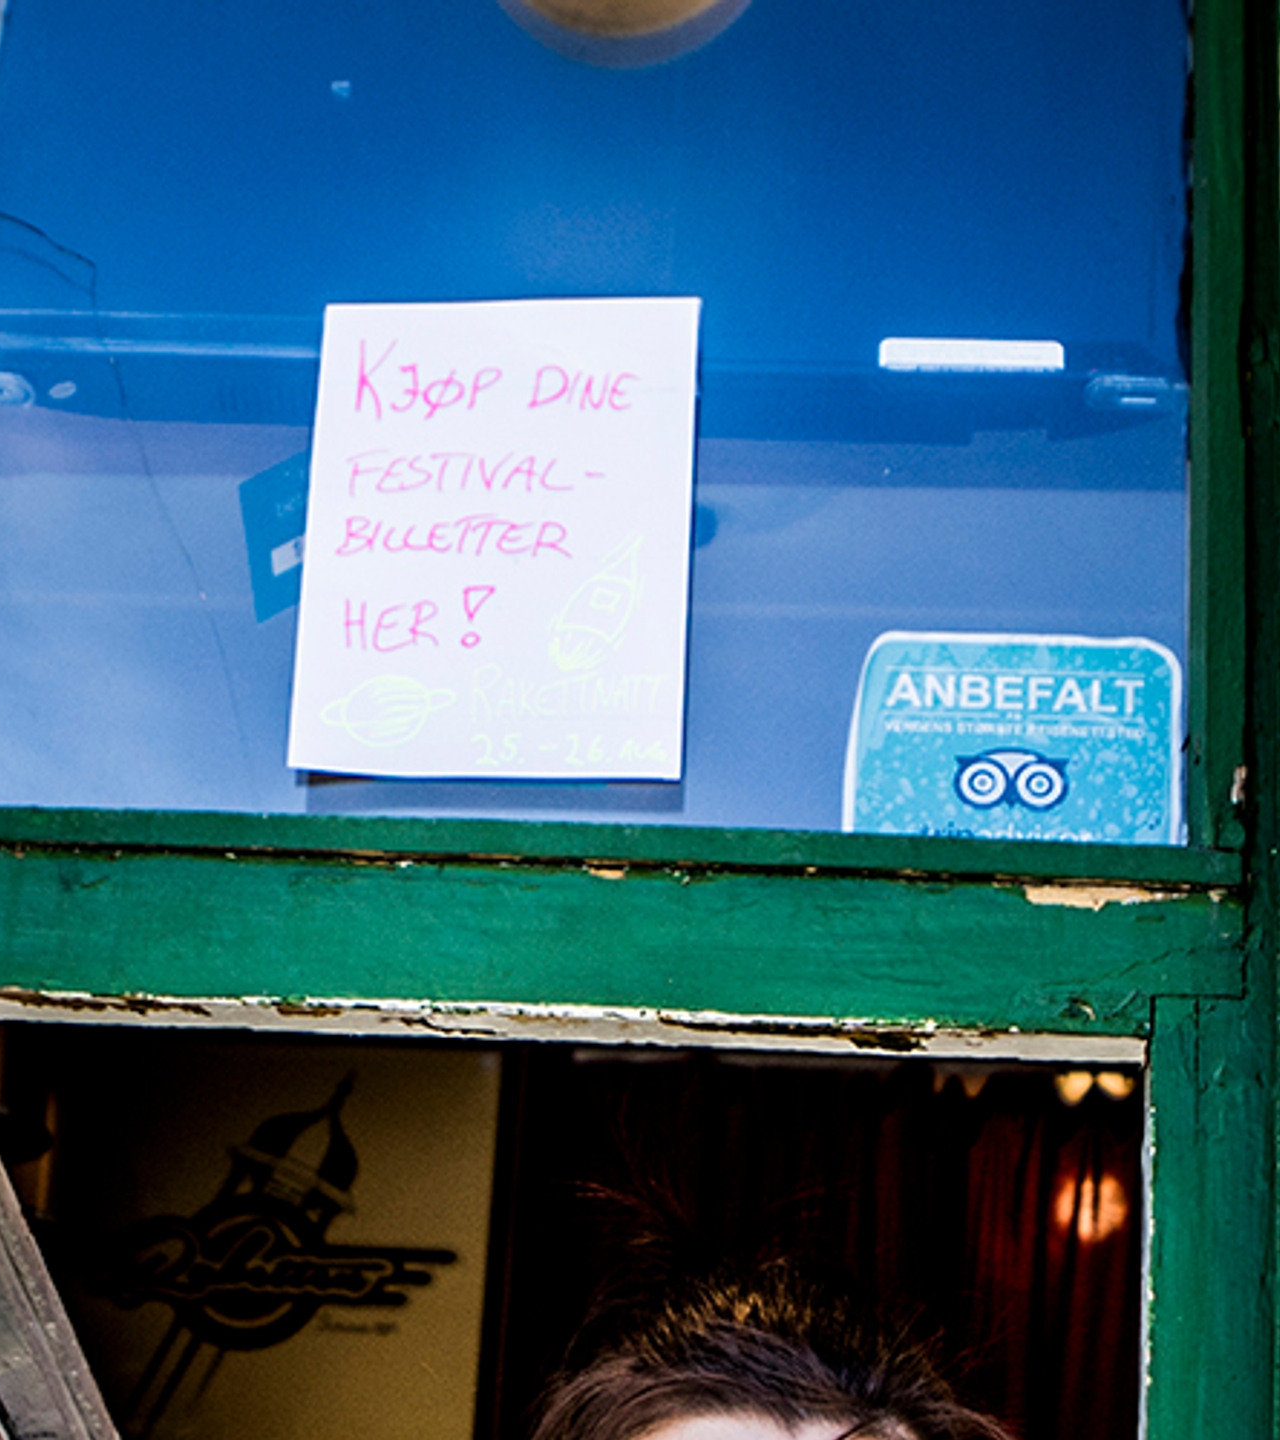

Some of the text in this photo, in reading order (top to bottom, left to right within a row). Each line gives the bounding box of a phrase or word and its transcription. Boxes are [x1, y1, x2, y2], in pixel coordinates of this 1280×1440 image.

[355, 339, 641, 420] KJØP DINE
[346, 448, 605, 496] FESTIVAL-
[335, 513, 573, 558] BILLETTER
[885, 672, 1145, 714] ANBEFALT
